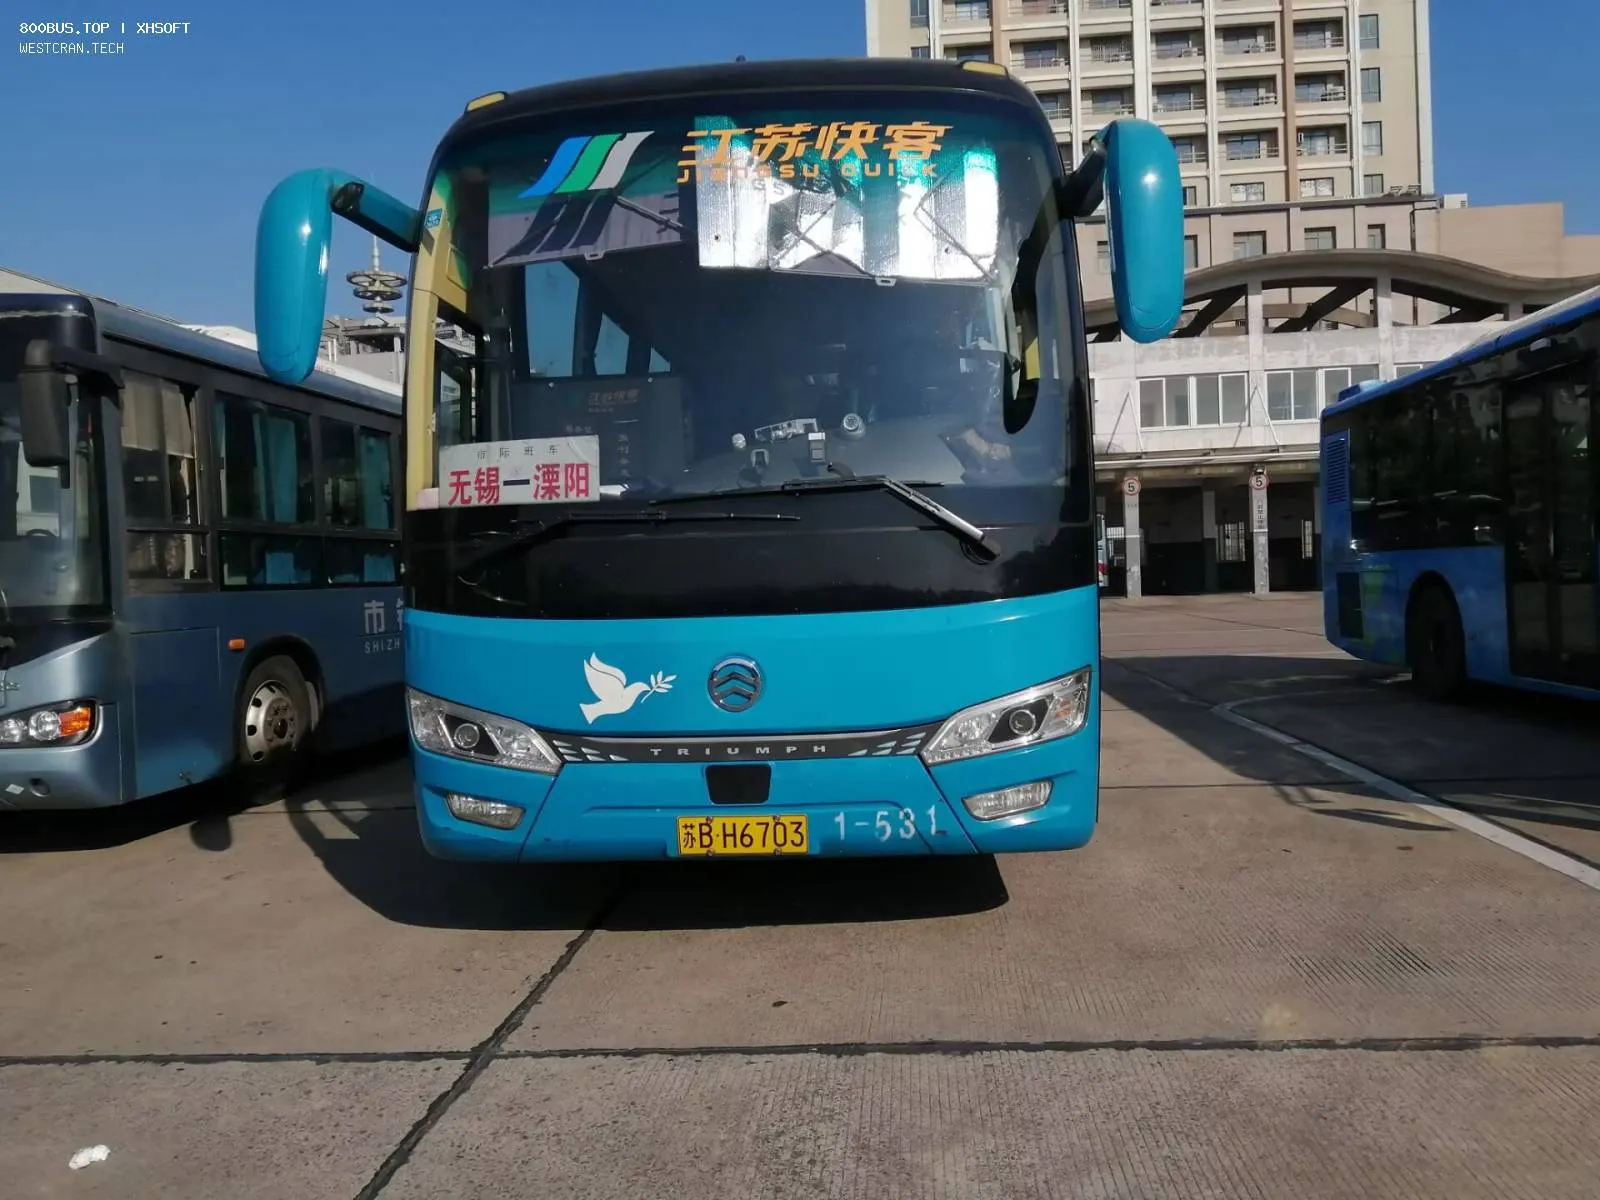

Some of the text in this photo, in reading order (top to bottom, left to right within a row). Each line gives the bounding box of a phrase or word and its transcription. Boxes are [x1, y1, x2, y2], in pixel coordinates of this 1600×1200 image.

[678, 121, 953, 167] 江苏快客
[840, 162, 939, 179] QUICK
[650, 745, 827, 756] TRIUMPH
[833, 803, 946, 842] 1-531
